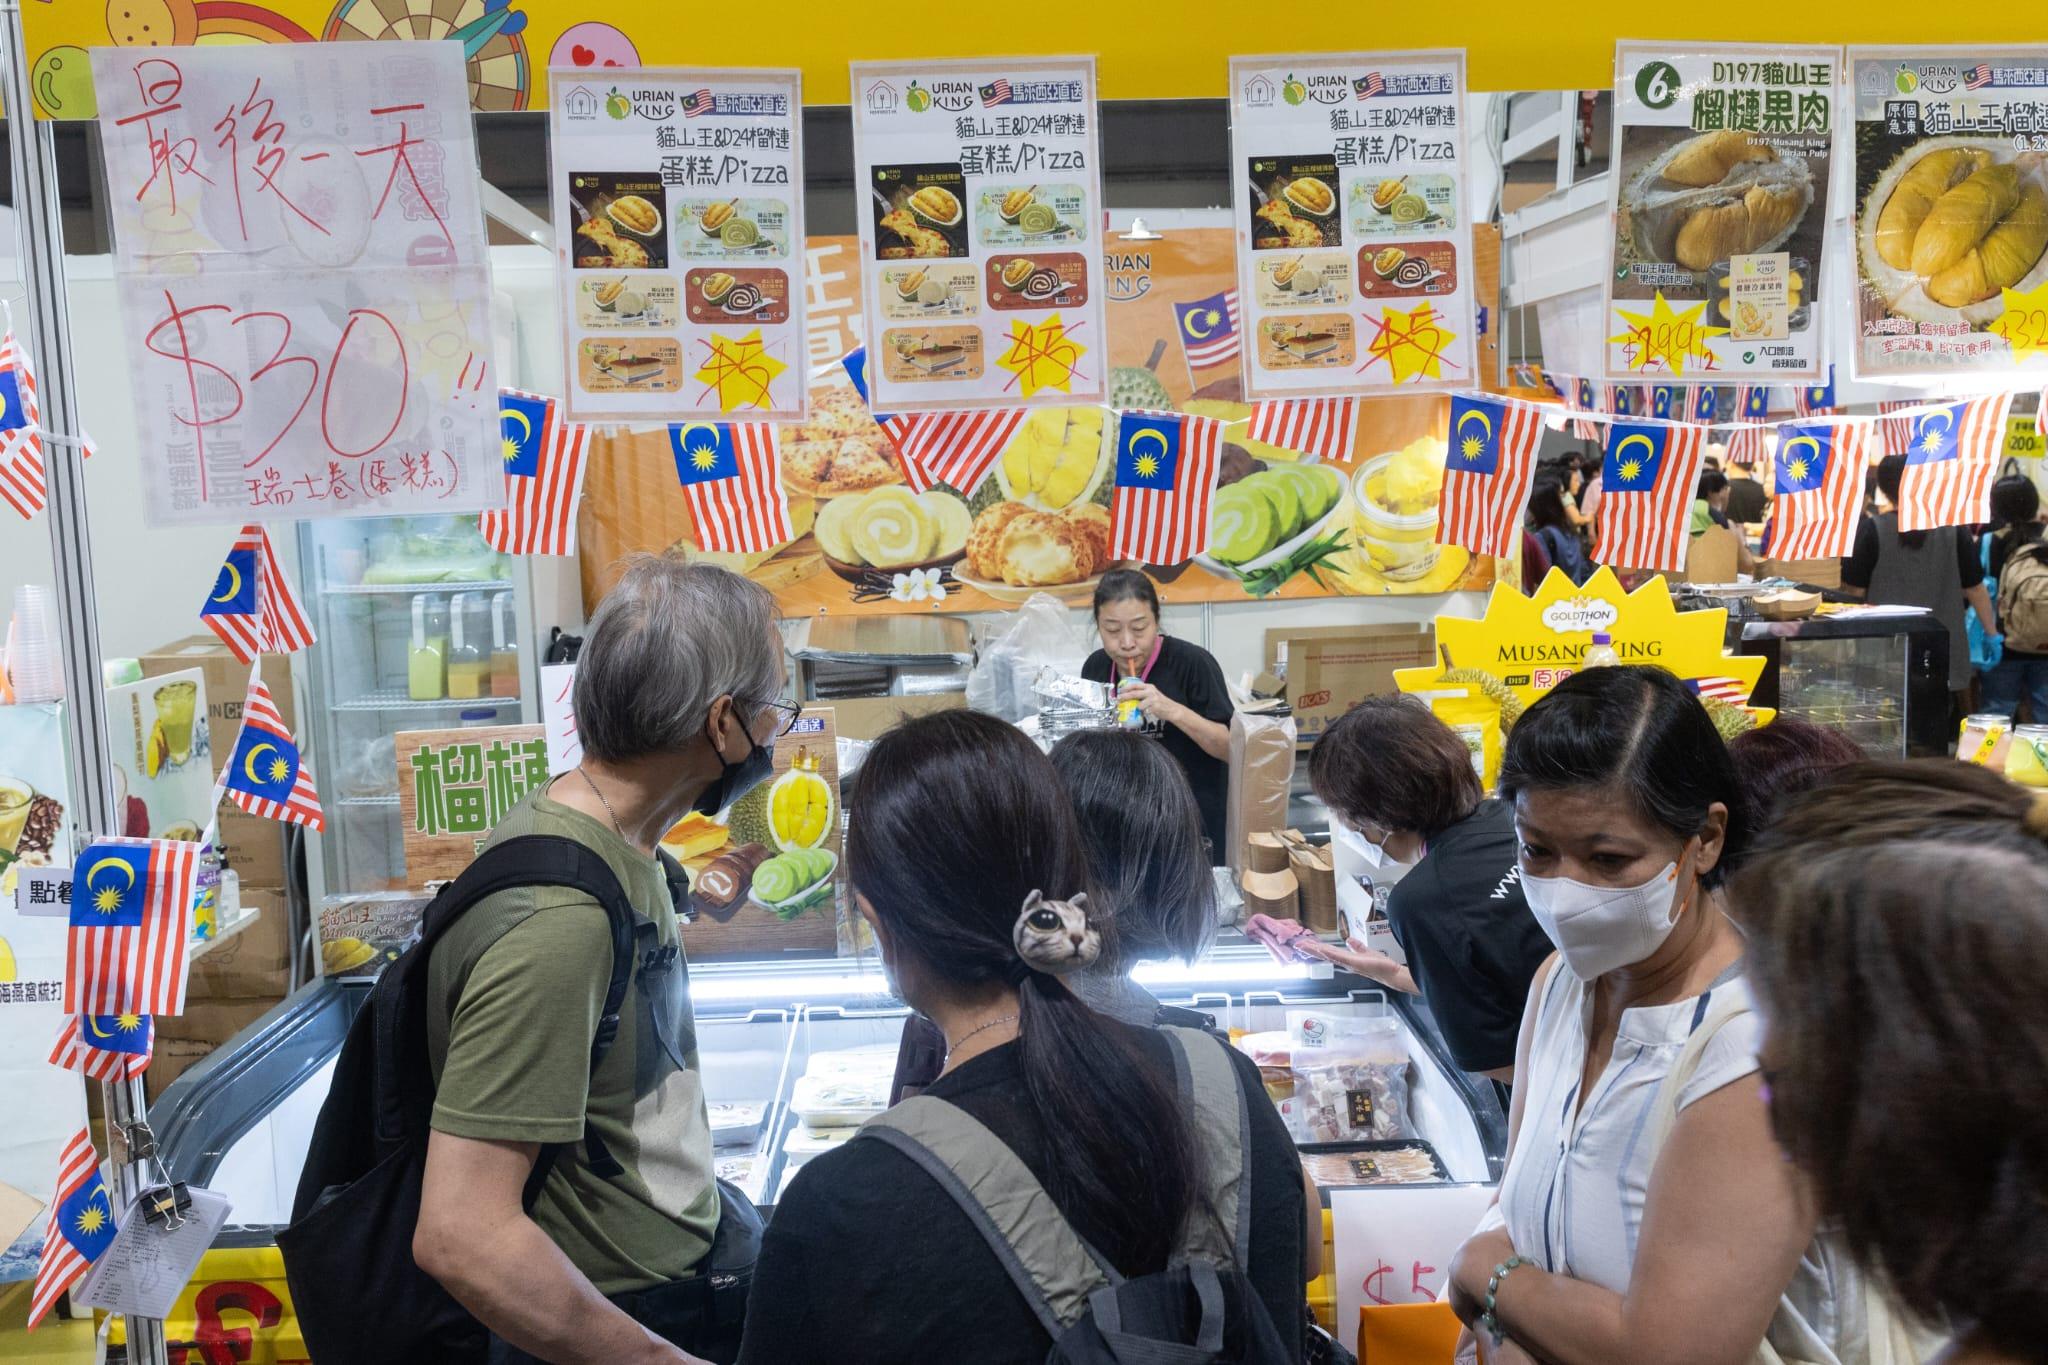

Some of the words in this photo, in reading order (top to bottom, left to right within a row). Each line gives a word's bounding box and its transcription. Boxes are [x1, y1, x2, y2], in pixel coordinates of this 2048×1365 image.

[1713, 61, 1831, 87] D197貓山王
[1919, 64, 1957, 77] URIAN
[1993, 67, 2048, 86] 馬來西亞直
[932, 81, 973, 94] URIAN
[1307, 75, 1347, 88] URIAN
[1385, 73, 1454, 95] 馬來西亞直送
[1647, 66, 1669, 104] 6
[1920, 79, 1957, 93] KING
[633, 89, 675, 102] URIAN
[1012, 80, 1083, 103] 馬來西亞直送
[1308, 89, 1347, 104] KING
[633, 105, 675, 120] KING
[715, 92, 788, 116] 馬來西亞直送
[933, 96, 974, 111] KING
[1692, 88, 1830, 134] 榴槤果肉
[115, 58, 455, 250] 最後一天
[959, 143, 1085, 175] 蛋糕/Pizza
[1333, 133, 1455, 167] 蛋糕/Pizza
[659, 154, 789, 187] 蛋糕/Pizza
[1104, 254, 1150, 271] RIAN
[1551, 610, 1611, 623] GOLDTHON
[1612, 640, 1662, 659] ING
